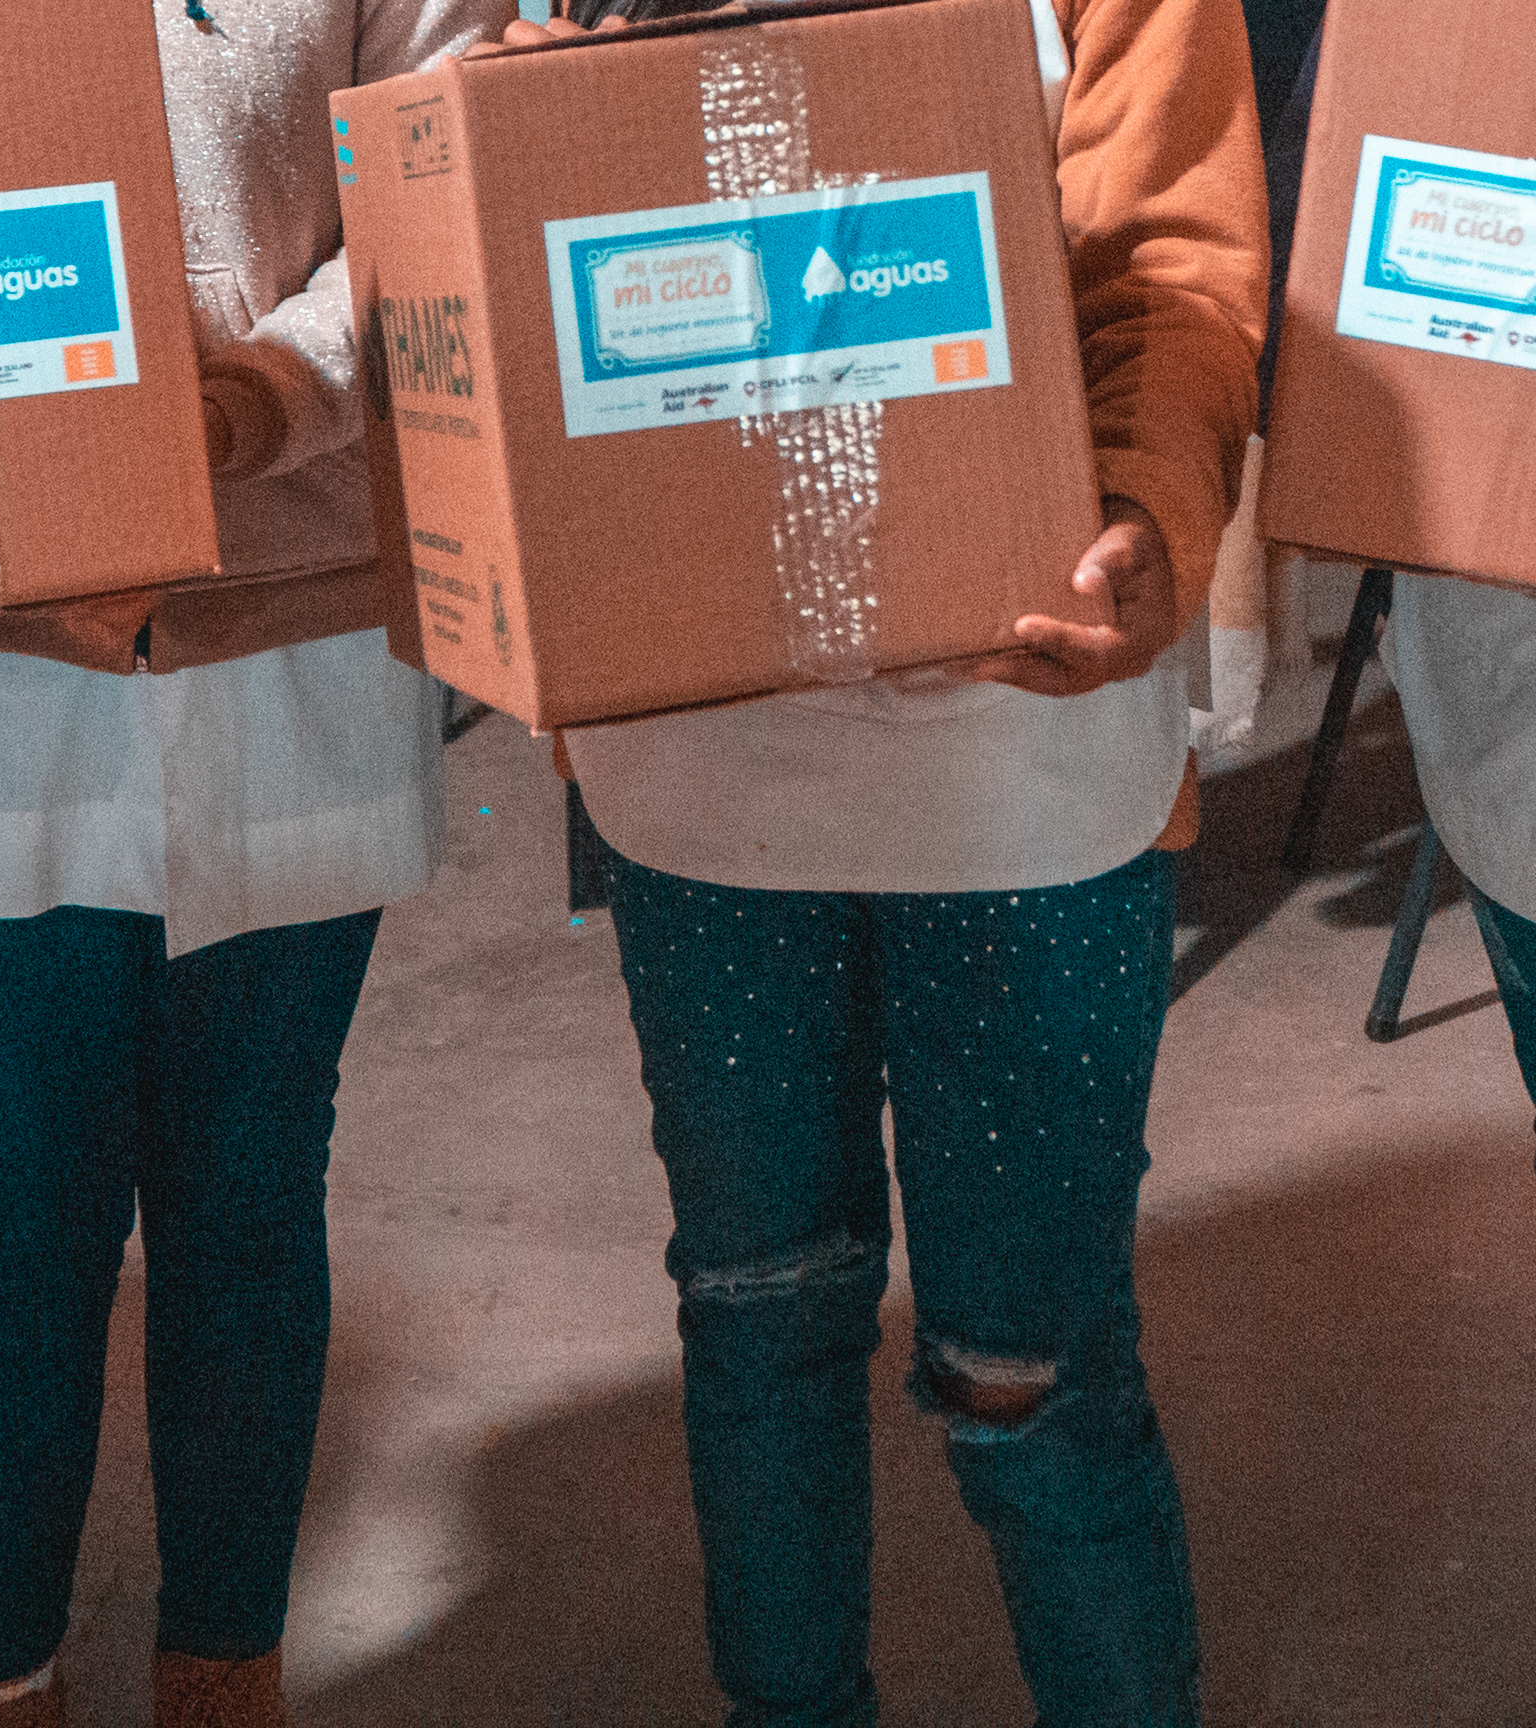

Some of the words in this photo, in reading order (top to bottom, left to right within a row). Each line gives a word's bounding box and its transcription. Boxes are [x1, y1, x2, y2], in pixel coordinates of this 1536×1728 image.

[1454, 215, 1525, 247] ciclo
[614, 278, 652, 308] mi
[661, 272, 732, 303] ciclo
[849, 258, 949, 298] aguas
